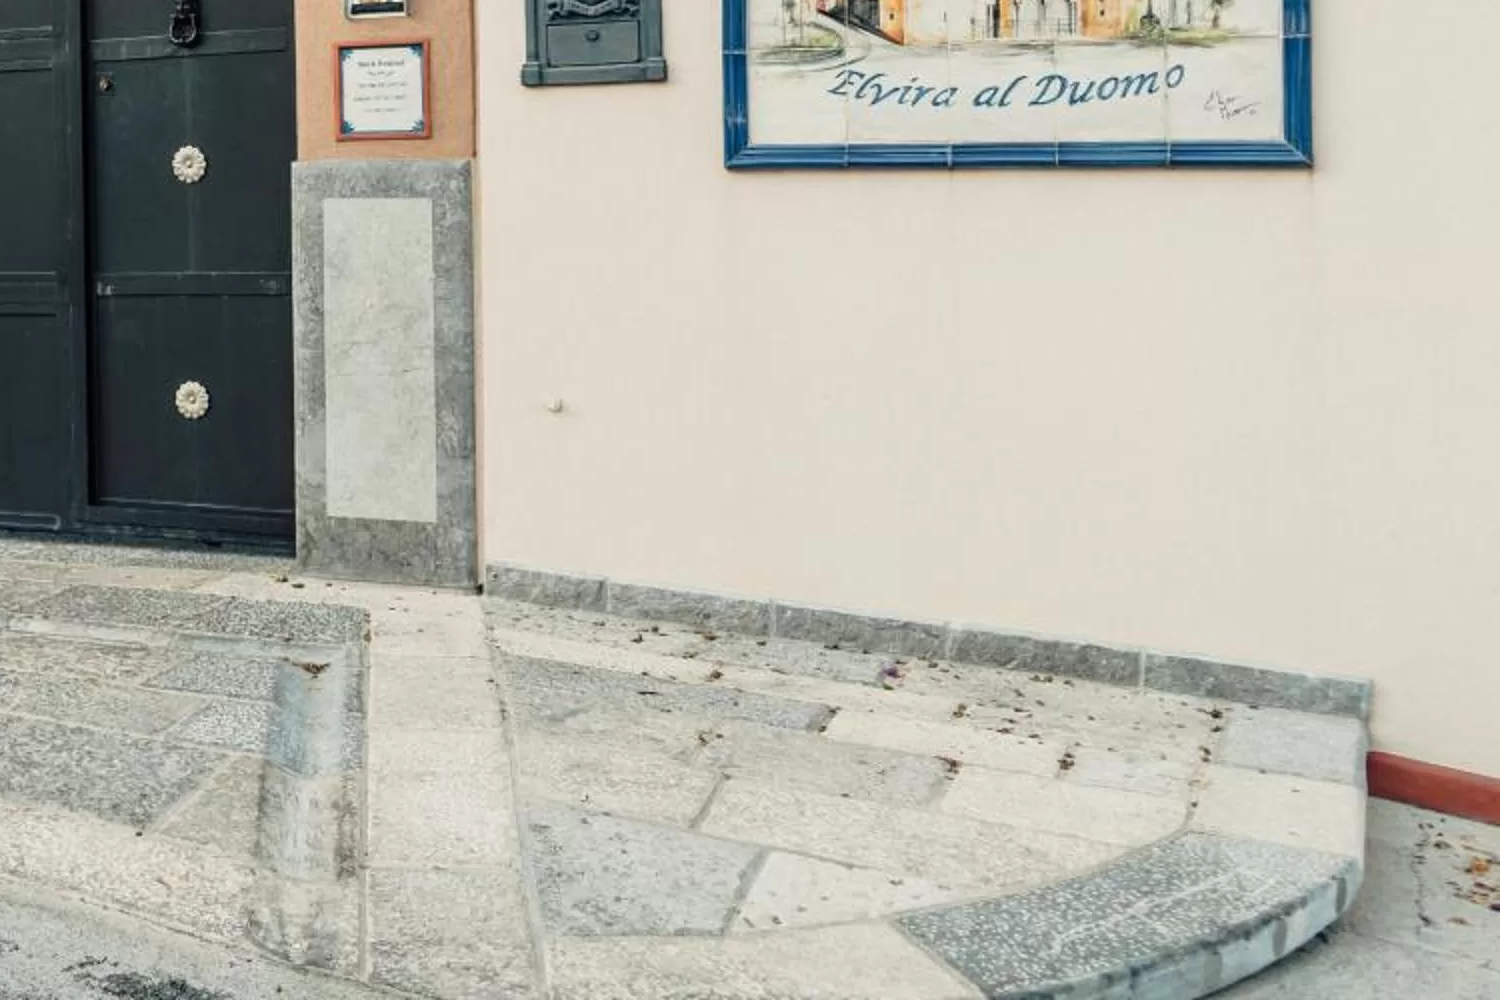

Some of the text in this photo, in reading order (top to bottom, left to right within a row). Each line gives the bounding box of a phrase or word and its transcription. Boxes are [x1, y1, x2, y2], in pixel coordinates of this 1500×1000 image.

[827, 67, 958, 108] Elvira
[972, 75, 1026, 108] al
[1028, 63, 1185, 107] Duomo
